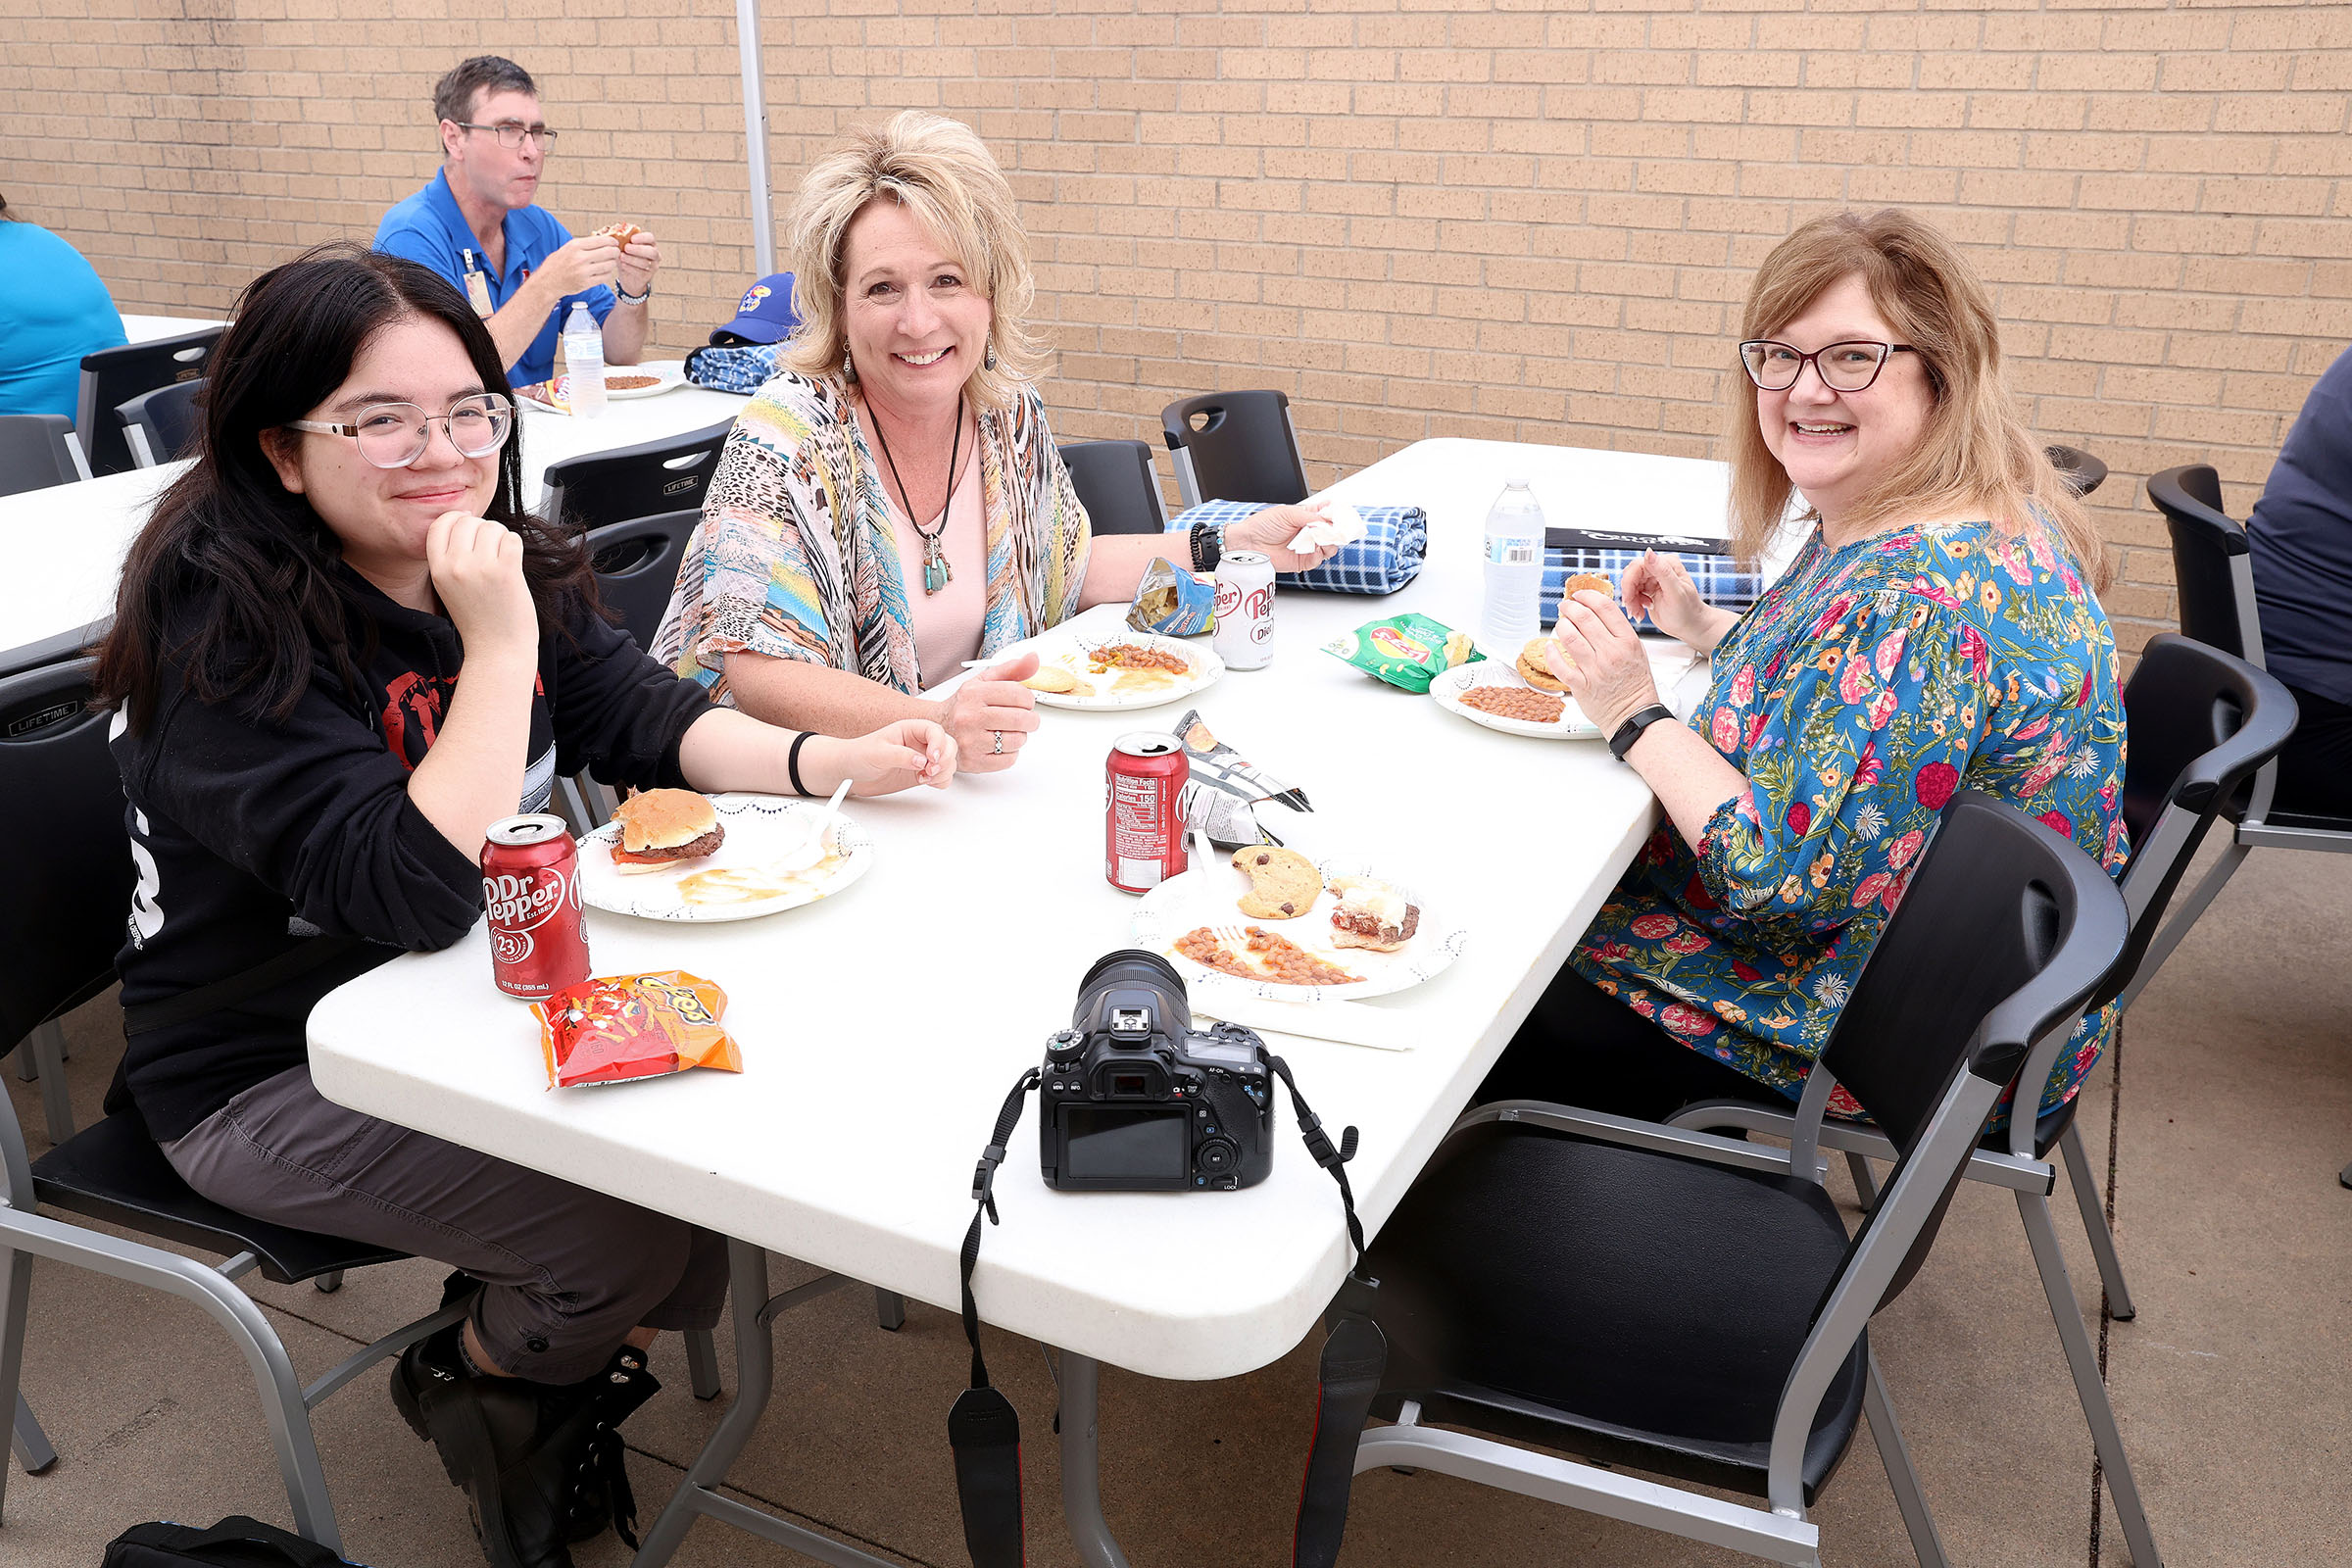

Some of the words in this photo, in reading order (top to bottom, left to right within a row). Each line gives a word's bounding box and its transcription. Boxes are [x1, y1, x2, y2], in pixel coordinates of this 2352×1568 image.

[667, 478, 694, 491] LIFETIME
[18, 706, 70, 731] LIFETIME
[1139, 794, 1155, 803] 150
[497, 874, 534, 901] Dr
[497, 937, 515, 956] 23
